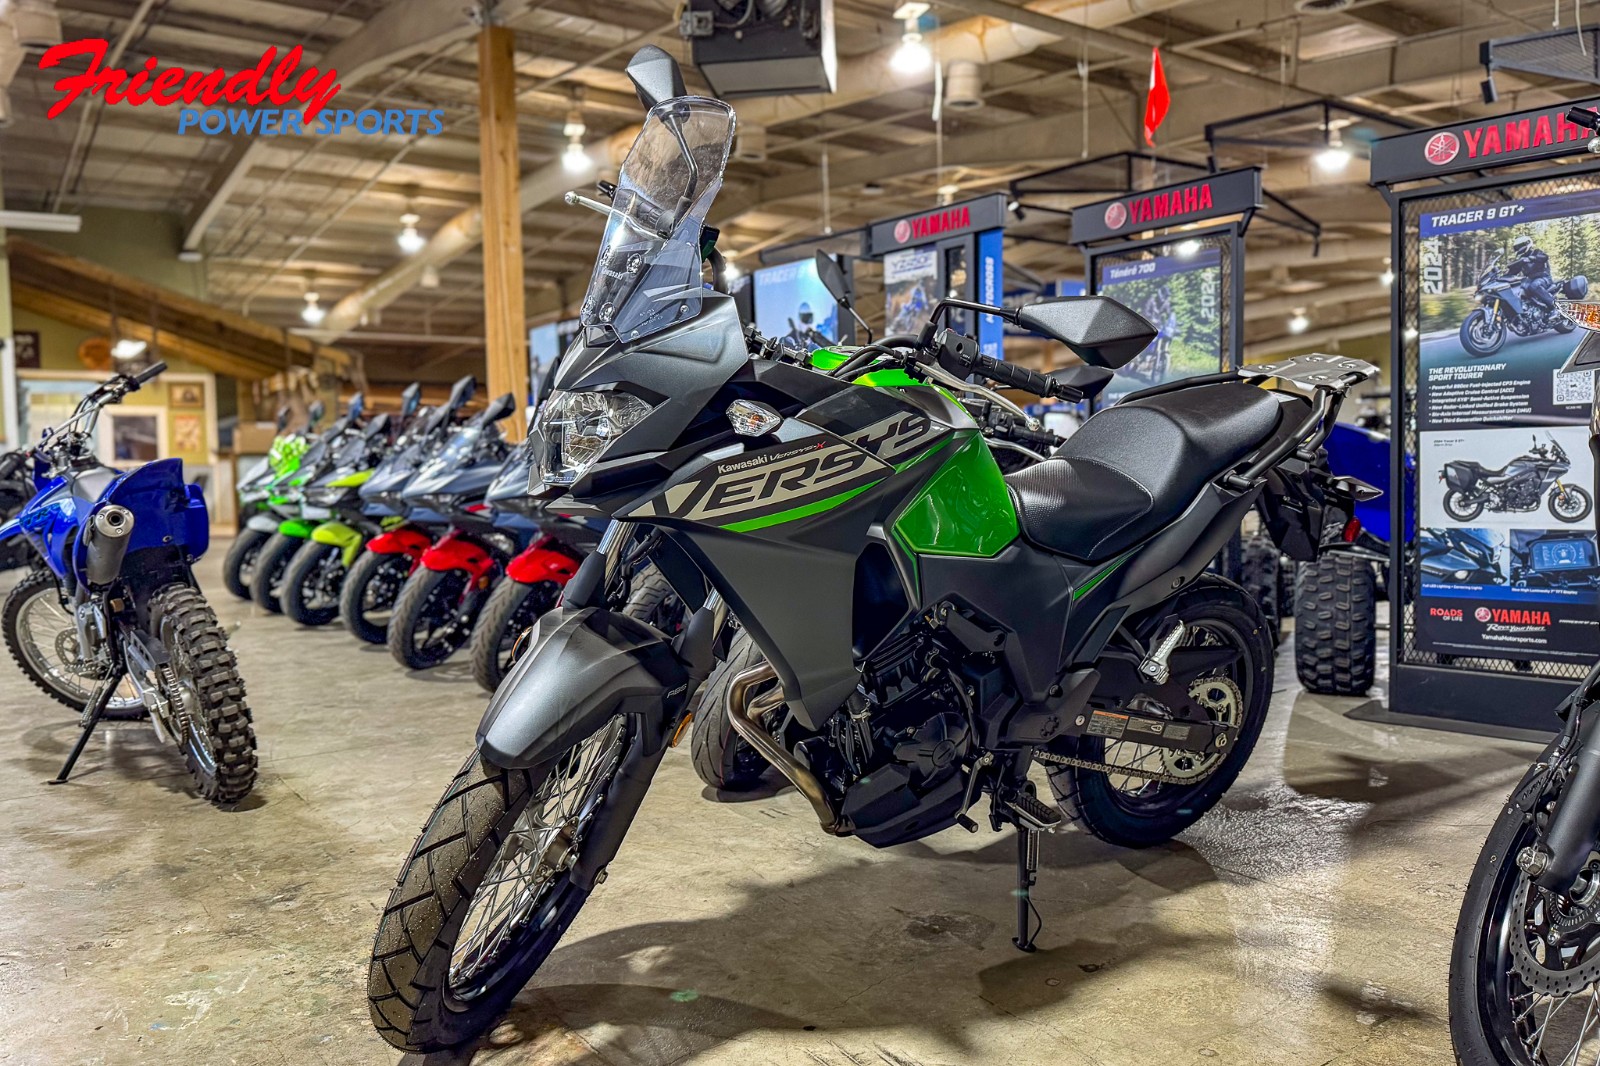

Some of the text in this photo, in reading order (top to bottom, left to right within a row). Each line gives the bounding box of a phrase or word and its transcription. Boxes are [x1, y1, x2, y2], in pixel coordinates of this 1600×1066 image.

[1128, 183, 1213, 225] YAMAHA
[911, 206, 971, 240] YAMAHA
[1432, 204, 1525, 228] TRACER 9 GT+
[1110, 262, 1156, 280] Ténéré 700
[1423, 240, 1443, 295] 2024
[1200, 270, 1215, 319] 2024
[1428, 372, 1484, 382] SPORT TOURER
[1444, 363, 1506, 374] REVOLUTIONARY
[651, 411, 932, 518] VERSYS
[717, 454, 769, 474] Kawasaki
[1430, 608, 1463, 617] ROADS
[1492, 608, 1551, 625] YAMAHA
[1486, 623, 1510, 632] Revs
[1509, 624, 1526, 632] Your
[1481, 633, 1548, 644] YamahaMotorsports.com
